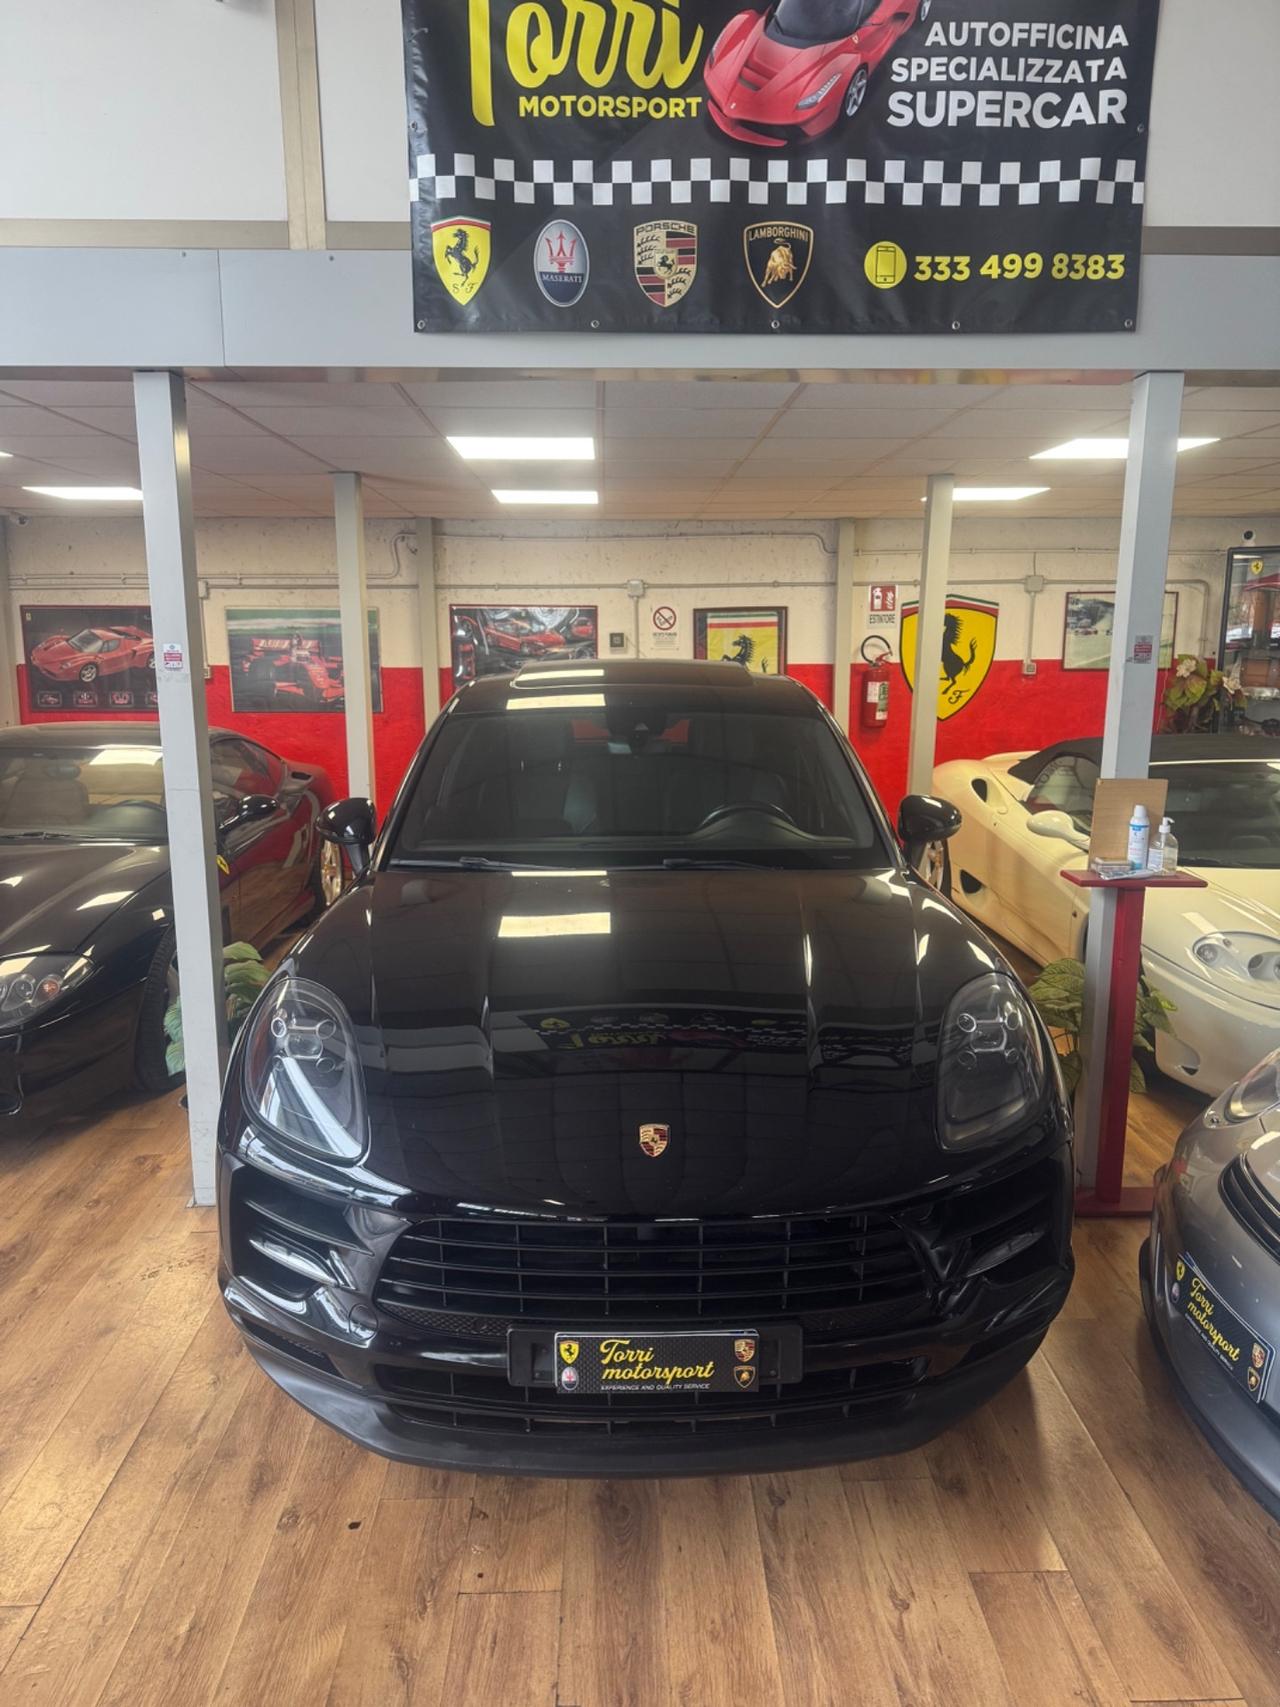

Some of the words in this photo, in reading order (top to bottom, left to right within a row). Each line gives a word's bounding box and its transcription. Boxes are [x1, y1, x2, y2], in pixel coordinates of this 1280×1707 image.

[924, 21, 1129, 50] AUTOFFICINA
[891, 56, 1127, 84] SPECIALIZZATA
[519, 95, 702, 118] MOTORSPORT
[887, 88, 1128, 129] SUPERCAR
[636, 222, 695, 236] PORSCHE
[749, 226, 809, 242] LAMBORGHINI
[542, 272, 583, 283] MASERATI
[914, 255, 971, 281] 333
[979, 252, 1044, 279] 499
[1051, 253, 1126, 280] 8383
[1190, 1277, 1214, 1316] Torri
[1187, 1301, 1240, 1361] motorsport
[600, 1338, 654, 1365] Torri
[602, 1361, 714, 1385] motorsport
